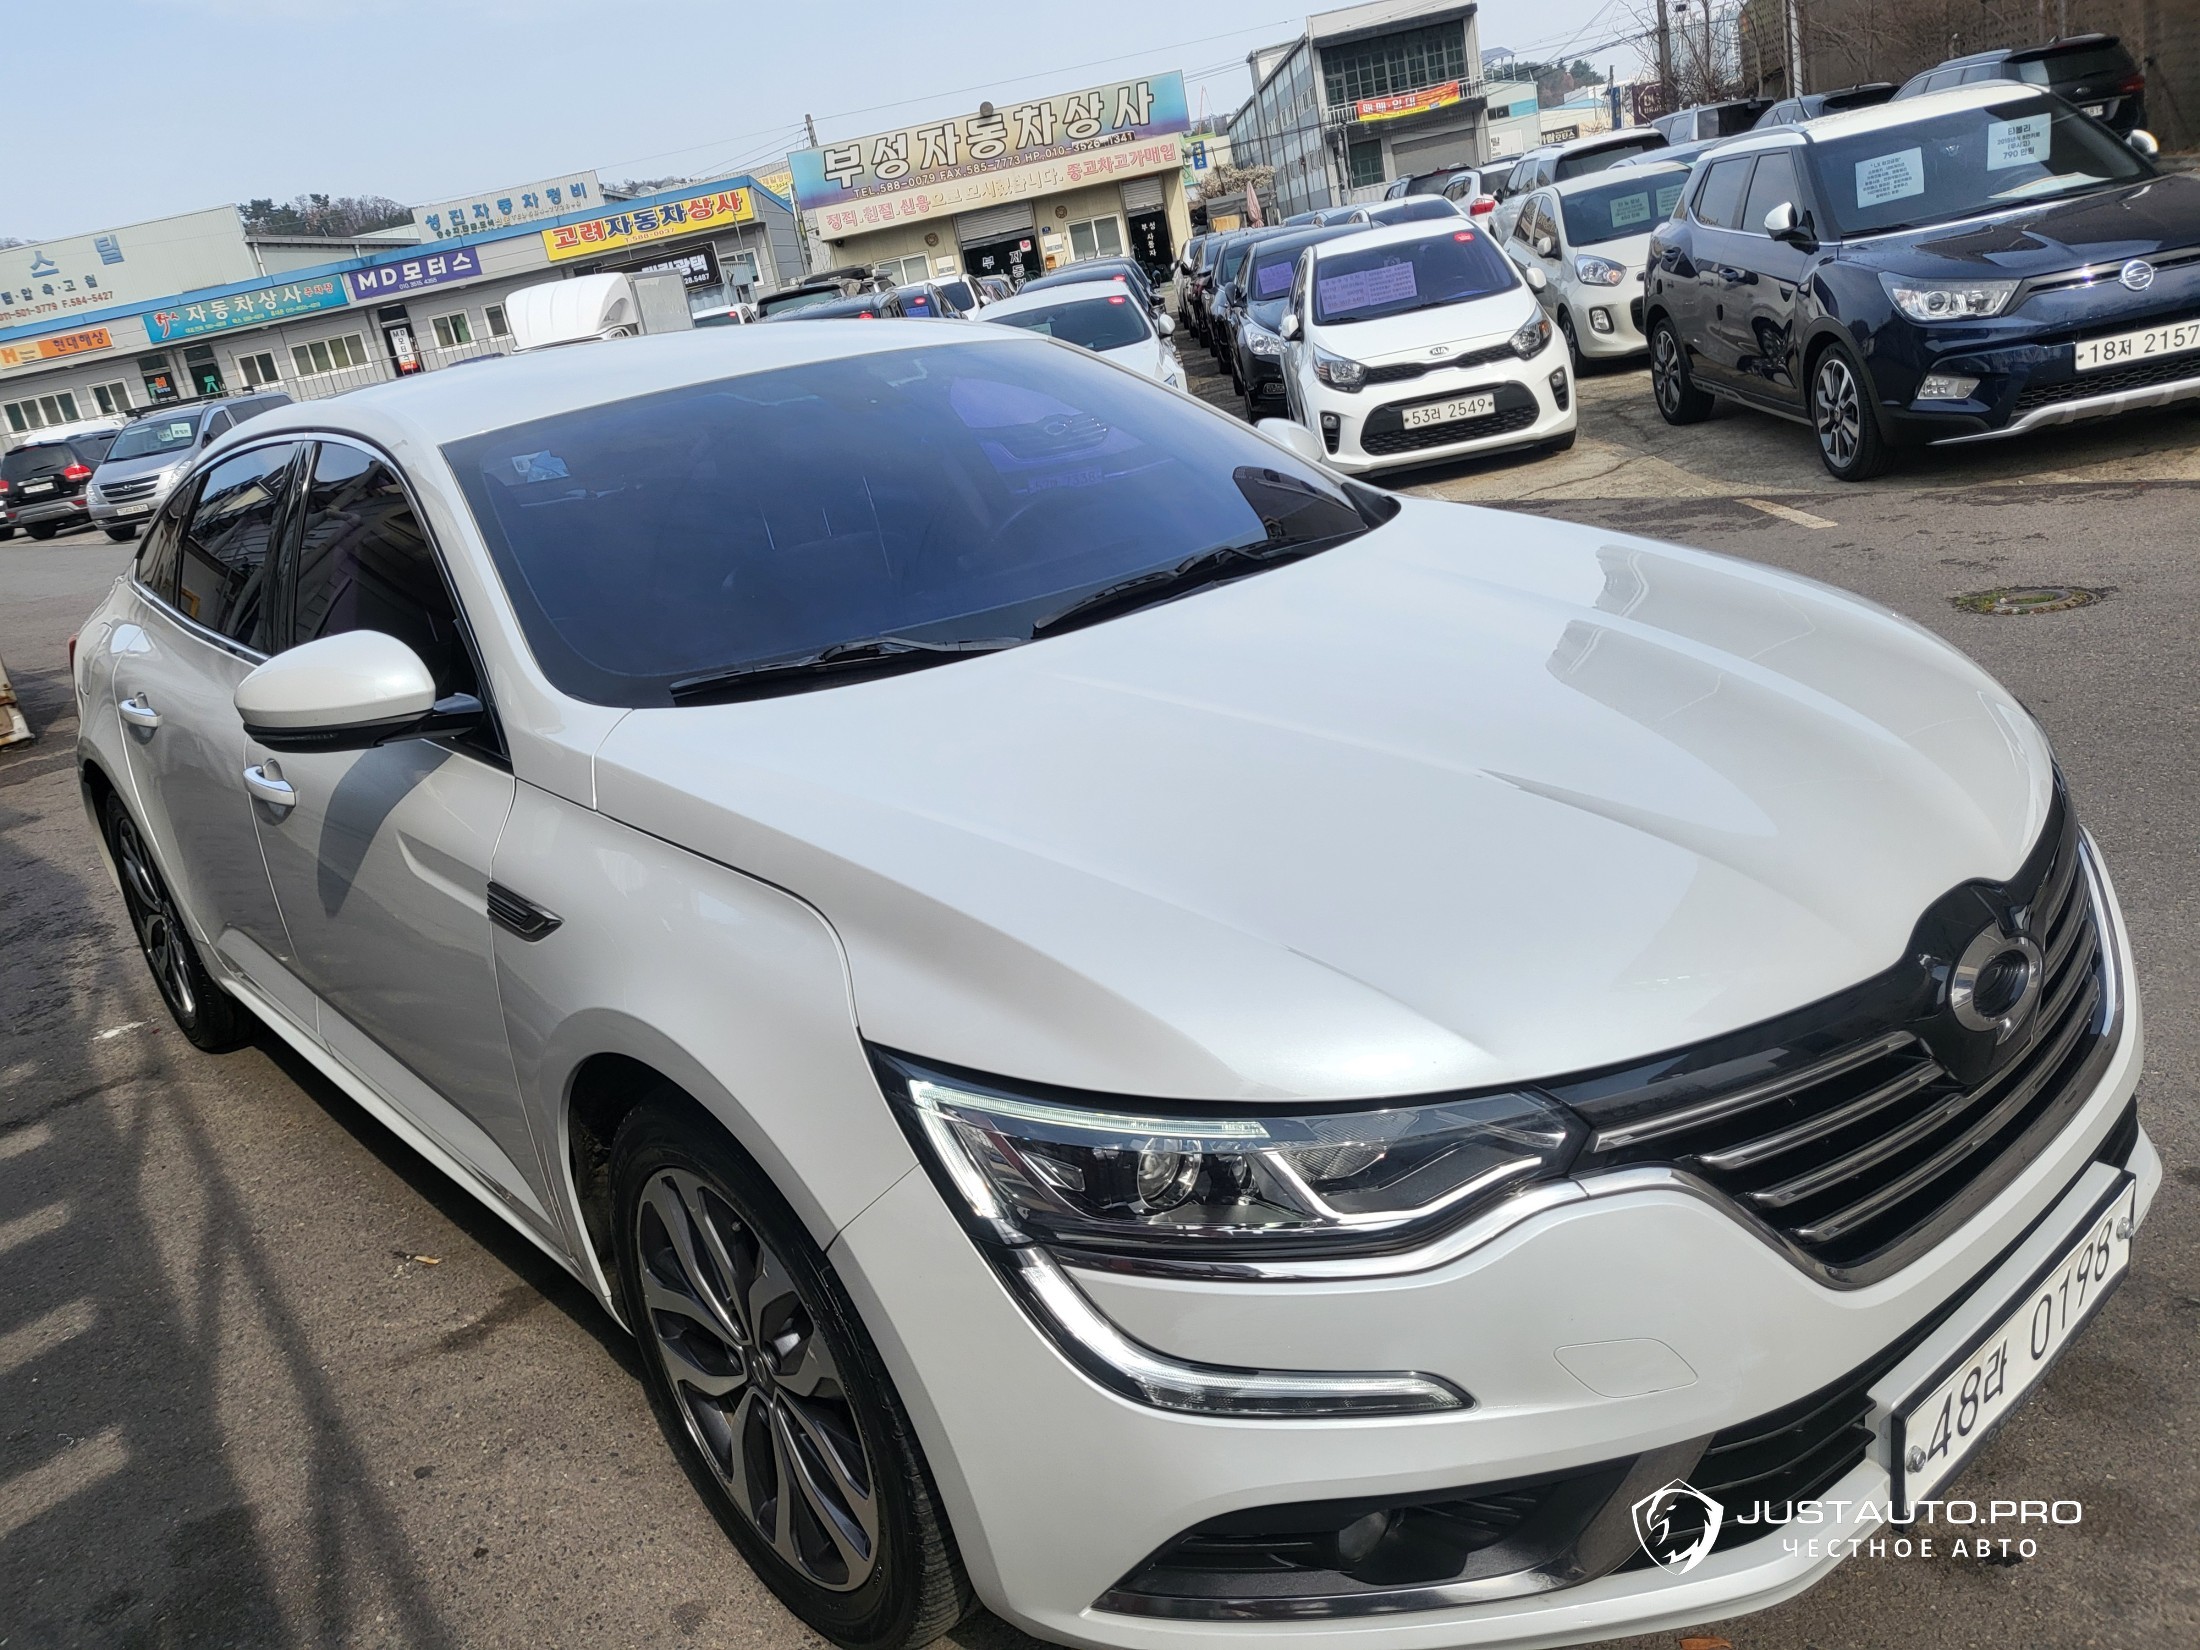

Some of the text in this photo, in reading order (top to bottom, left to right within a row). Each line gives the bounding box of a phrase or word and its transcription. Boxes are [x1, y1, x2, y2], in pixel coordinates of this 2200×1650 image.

[825, 81, 1154, 190] 부성자동차상사
[2002, 149, 2019, 160] 790
[852, 172, 937, 199] TEL.588-0079
[939, 155, 1020, 182] FAX.585-7773
[425, 182, 588, 232] 성진자동차정비
[551, 190, 743, 250] 고려자동차상사
[624, 227, 676, 244] T.588-0037
[982, 255, 995, 270] 부
[187, 284, 303, 323] 자동차상사
[303, 282, 334, 298] 주차장
[52, 331, 104, 352] 현대해상
[1430, 346, 1450, 356] KIA
[2089, 323, 2200, 364] 18저 2157
[1447, 398, 1487, 420] 2549
[1927, 1337, 2008, 1459] 48라
[2029, 1215, 2113, 1361] 0198
